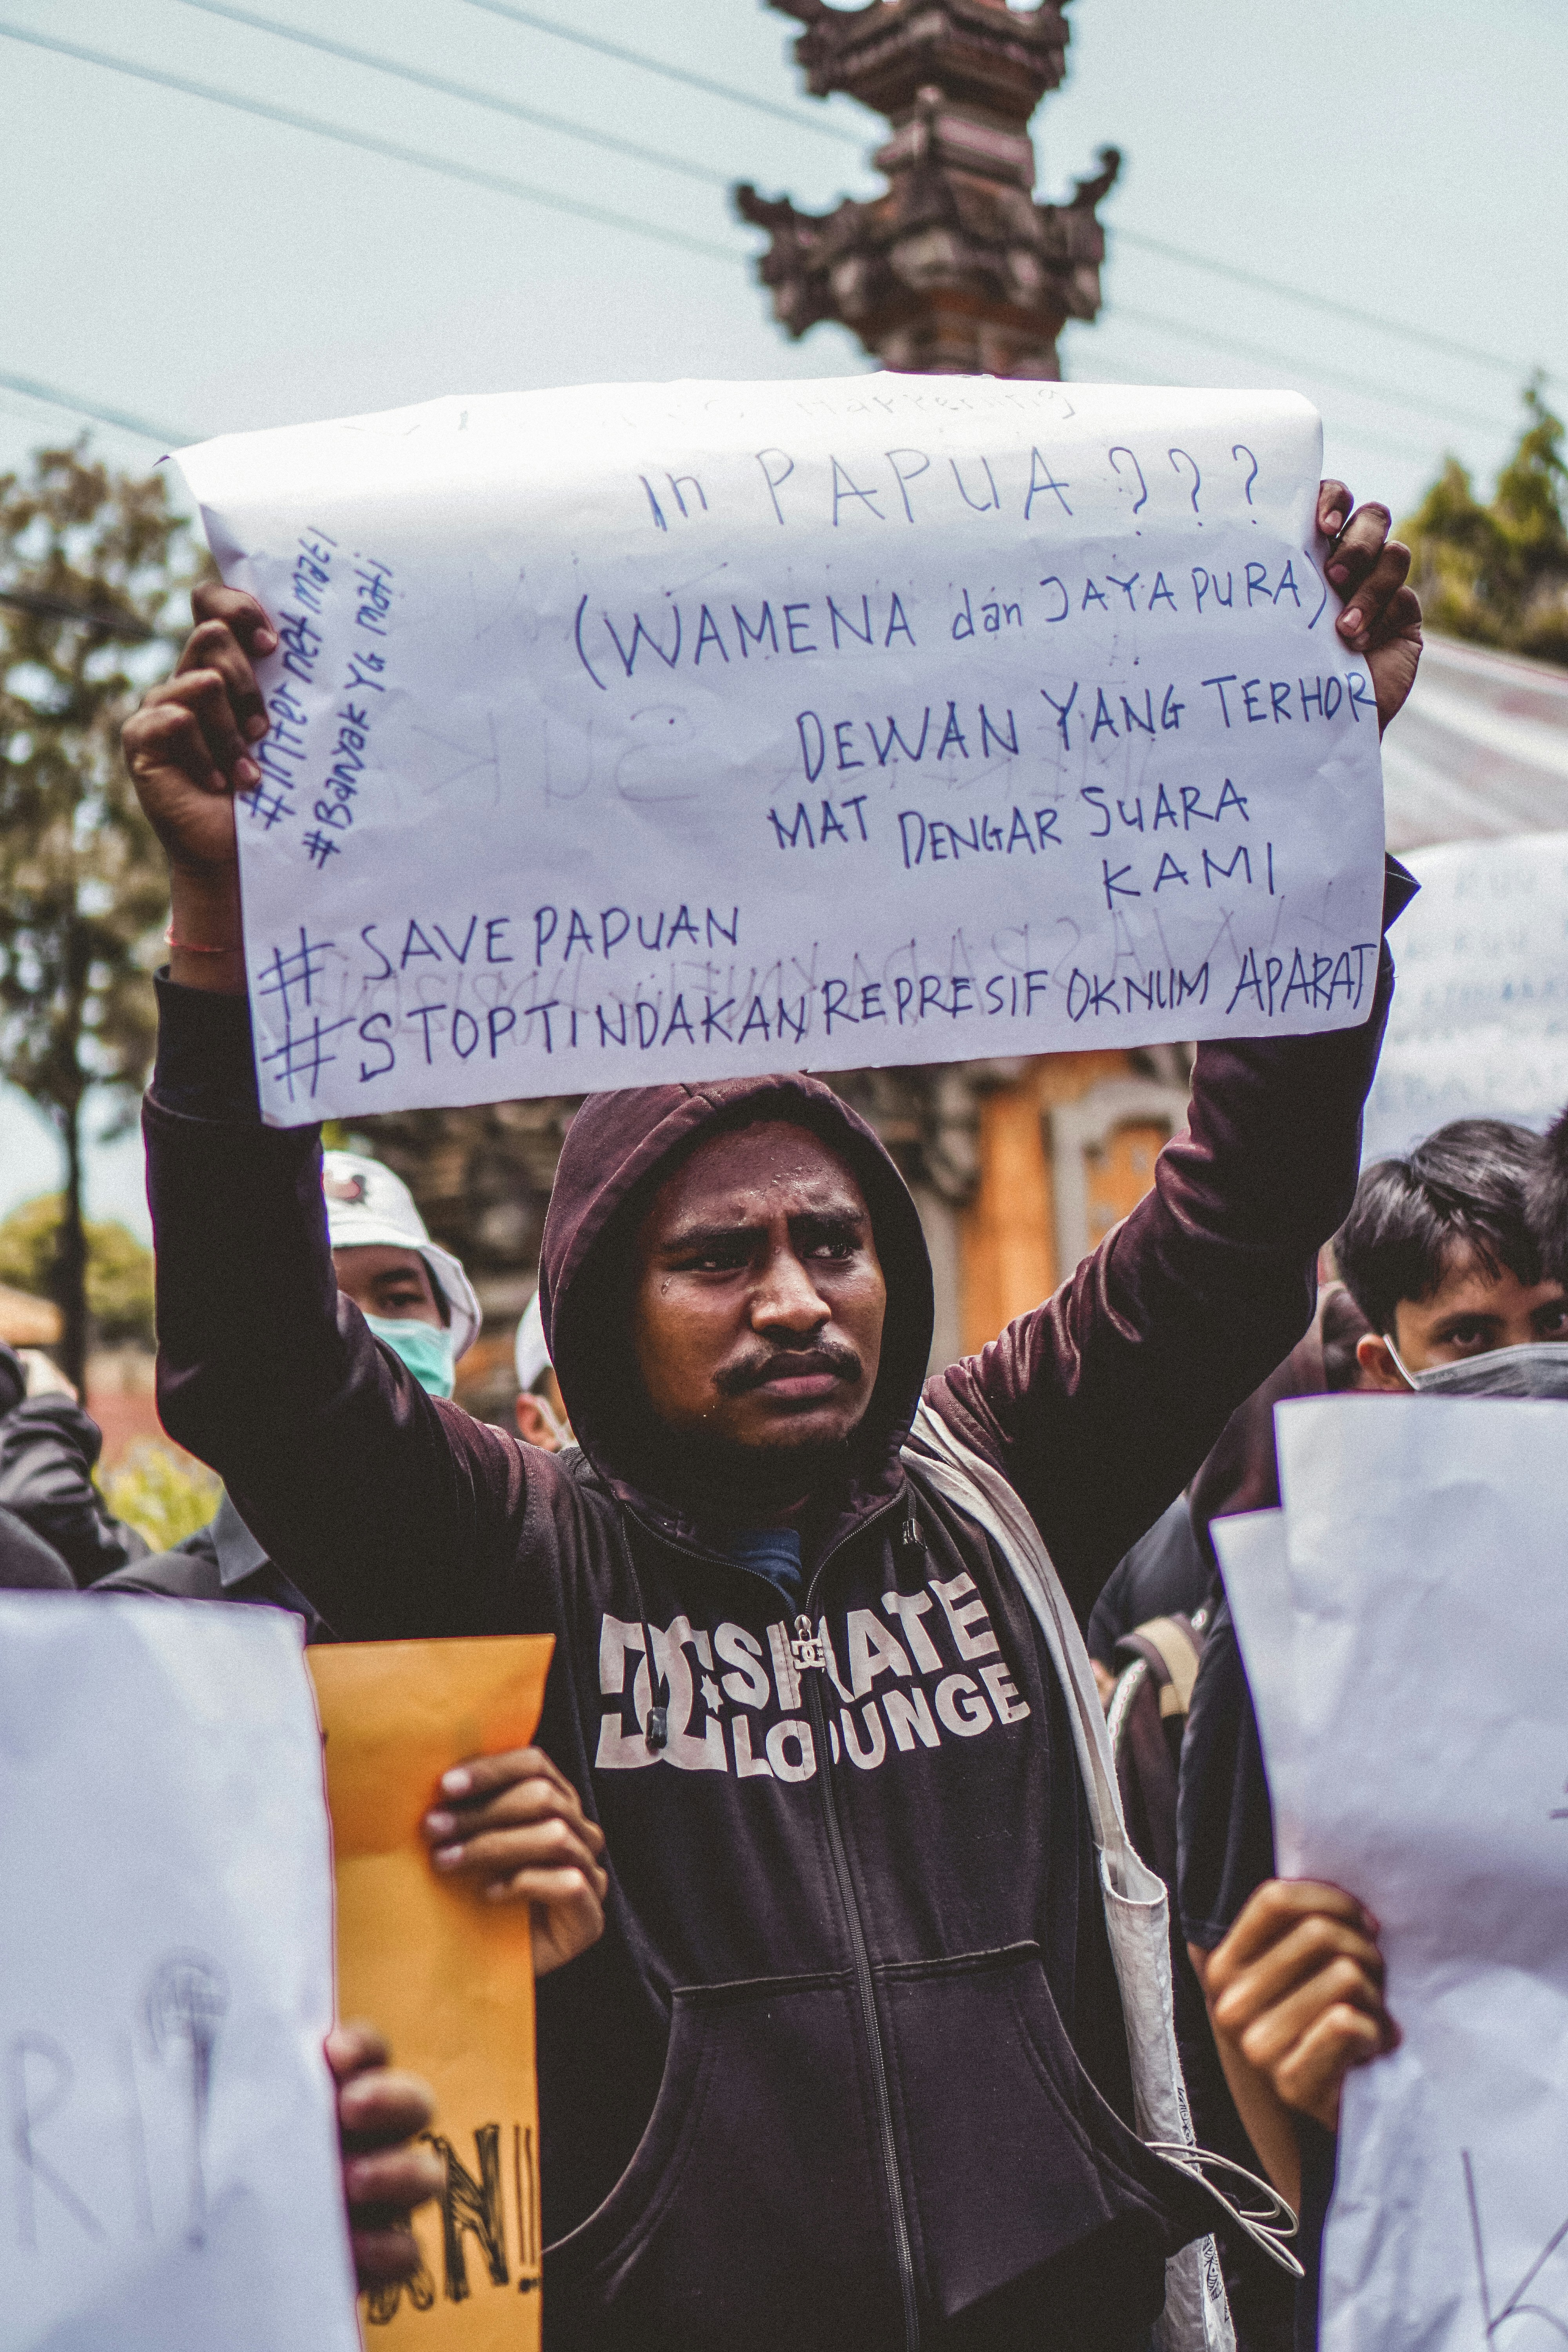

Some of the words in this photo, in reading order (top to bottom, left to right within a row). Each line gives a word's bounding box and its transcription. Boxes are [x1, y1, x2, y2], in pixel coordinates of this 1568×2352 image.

[574, 593, 916, 690] (WAMENA
[797, 700, 1020, 783] DEWAN
[1041, 681, 1186, 751] YANG
[1201, 671, 1377, 728] TERHOR
[767, 795, 868, 850] MAT
[897, 806, 1063, 869] DENGAR
[1101, 842, 1276, 910] KAMI
[1225, 944, 1377, 1016] APARAT
[731, 1662, 1031, 1782] LOUNGE
